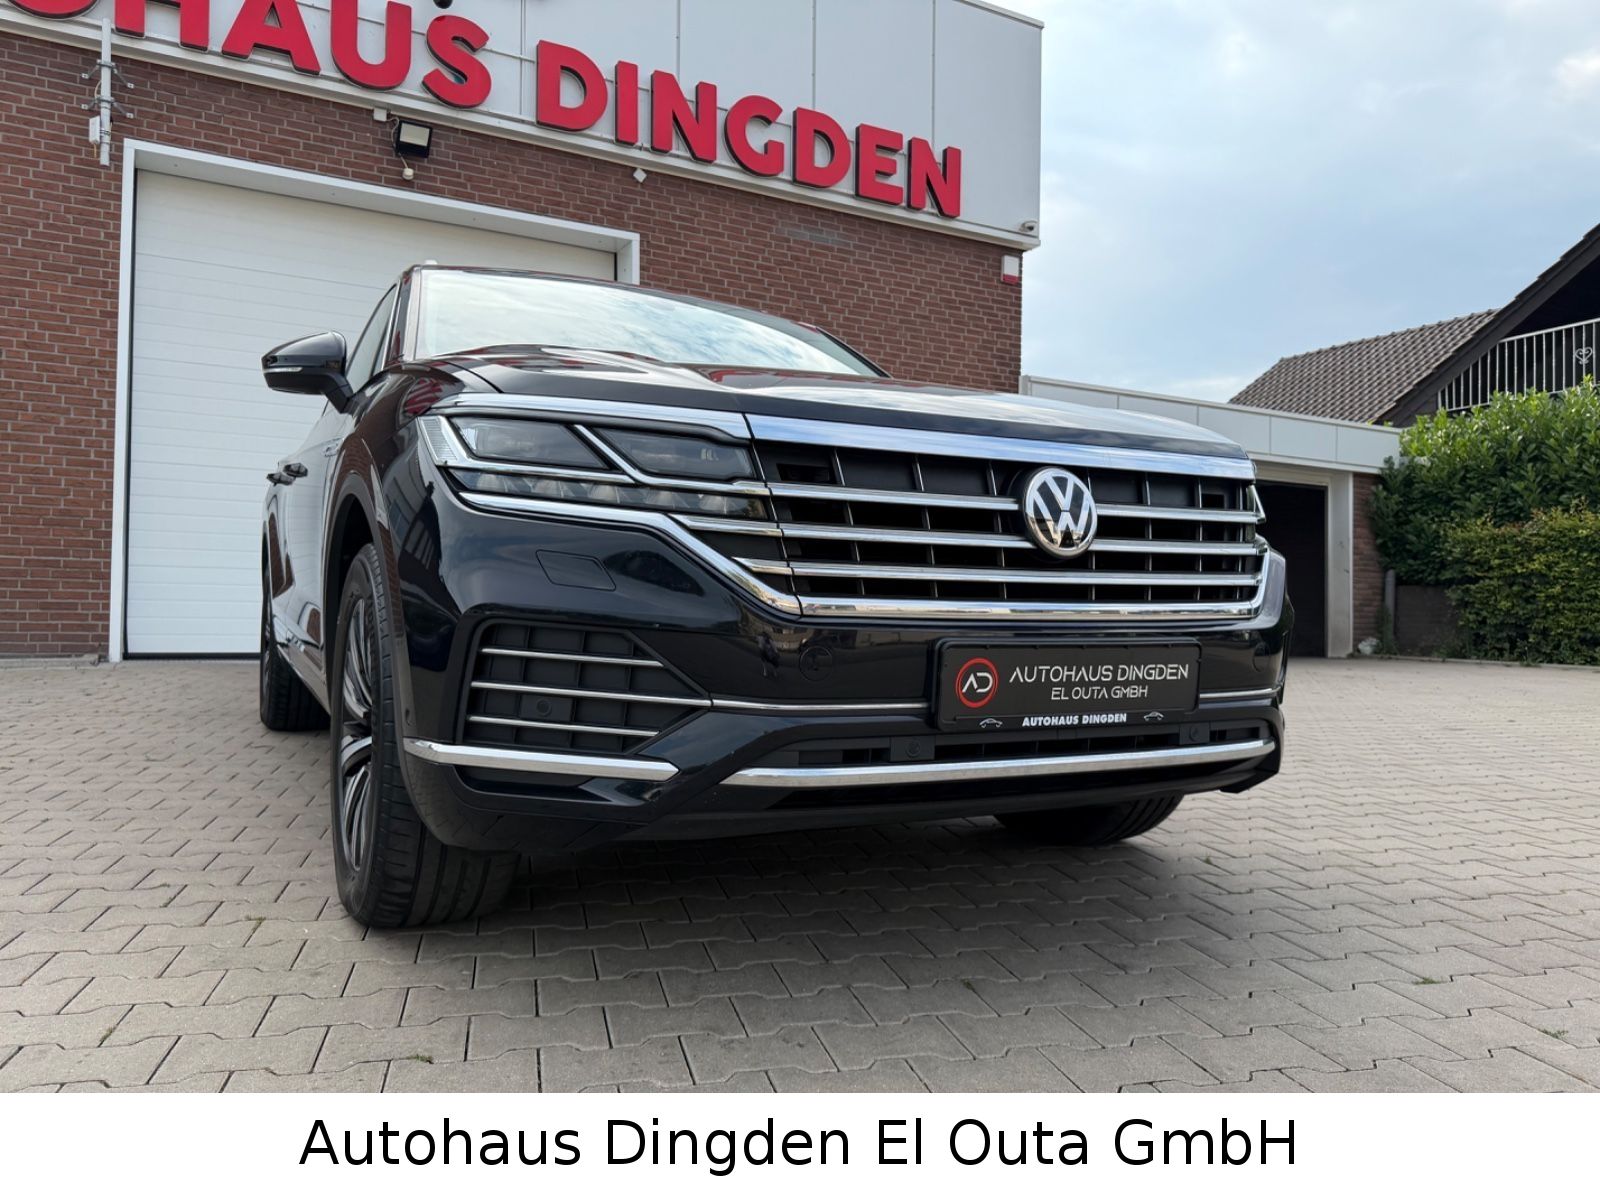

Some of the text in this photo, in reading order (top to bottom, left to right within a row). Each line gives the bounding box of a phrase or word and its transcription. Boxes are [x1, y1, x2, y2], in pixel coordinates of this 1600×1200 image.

[5, 0, 962, 218] AUS DINGDEN
[1009, 663, 1189, 683] AUTOHAUS DINGDEN
[1050, 684, 1149, 701] EL OUTA GMBH
[1022, 712, 1127, 727] AUTOHAUS DINGDEN
